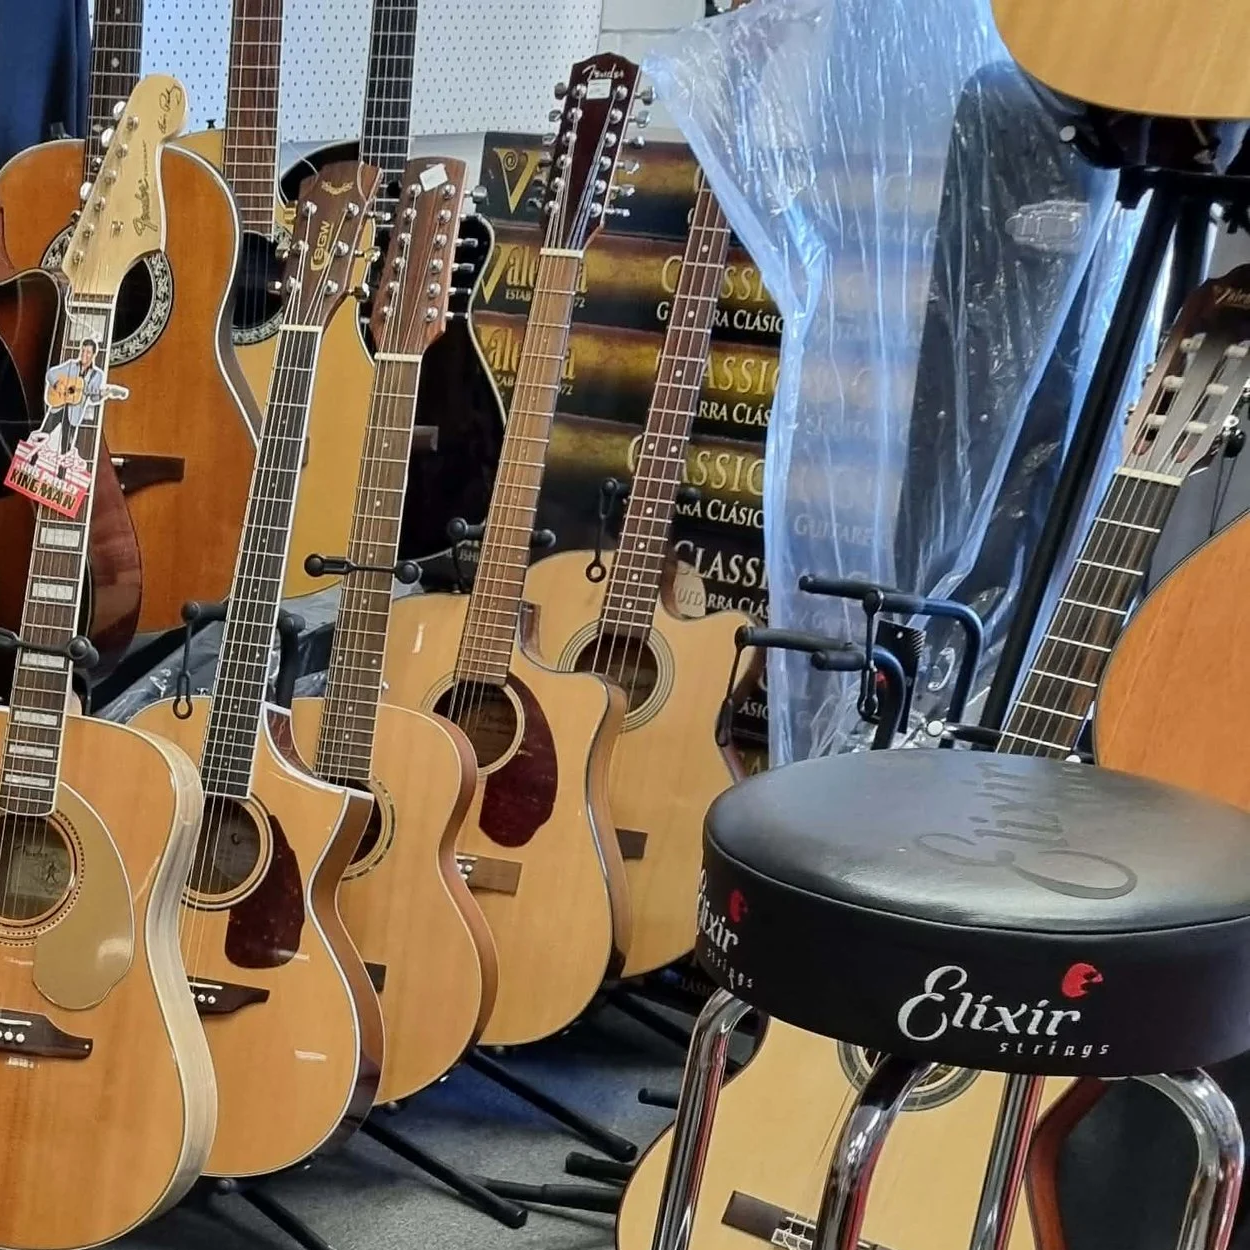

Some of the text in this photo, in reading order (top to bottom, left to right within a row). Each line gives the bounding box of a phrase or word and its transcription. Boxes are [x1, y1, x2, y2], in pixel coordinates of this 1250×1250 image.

[9, 467, 77, 510] KINGMAN
[897, 965, 1081, 1042] Elixir
[999, 1040, 1110, 1059] strings
